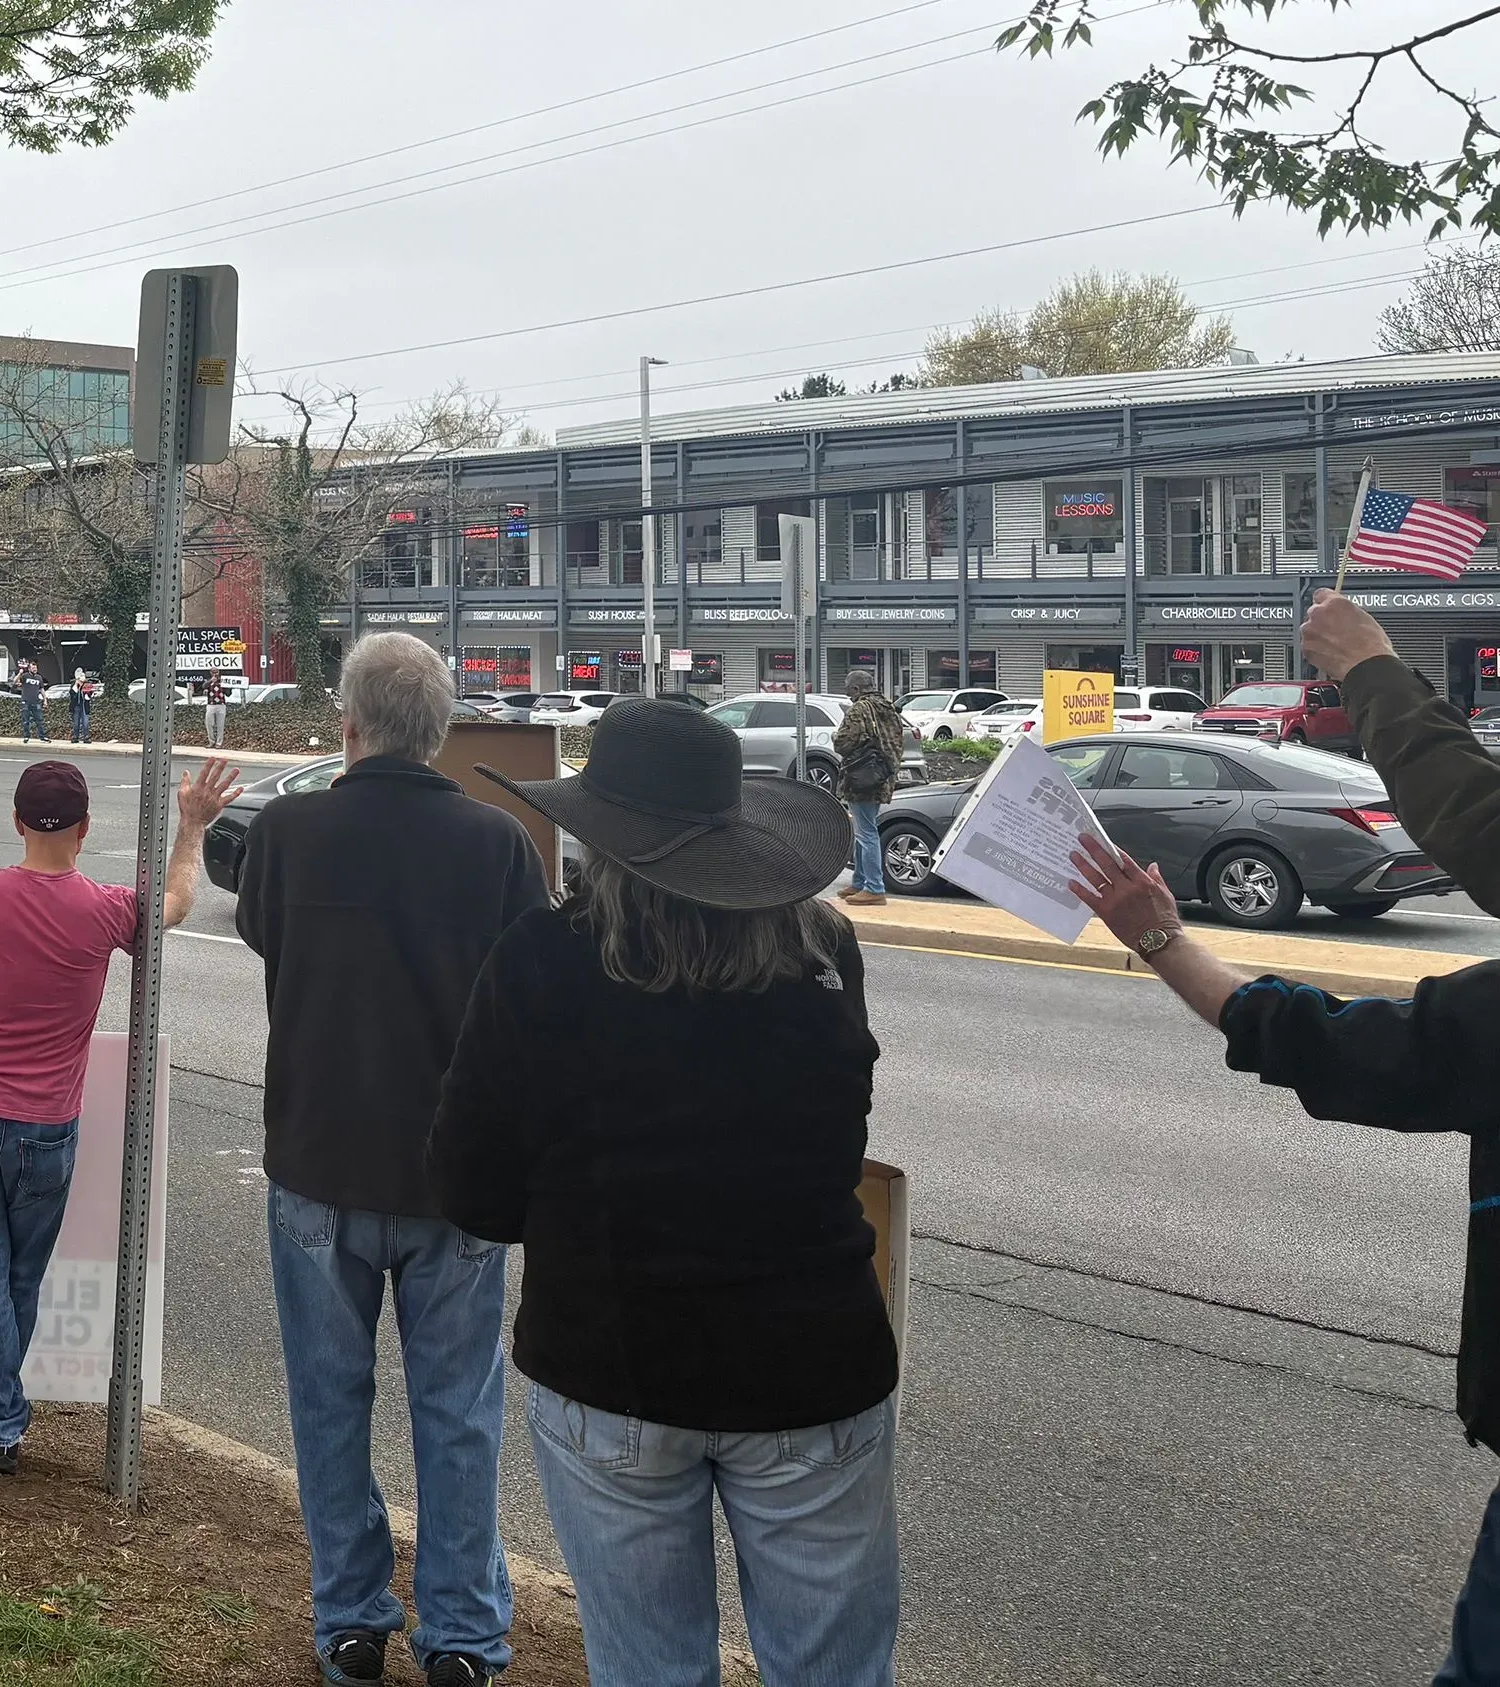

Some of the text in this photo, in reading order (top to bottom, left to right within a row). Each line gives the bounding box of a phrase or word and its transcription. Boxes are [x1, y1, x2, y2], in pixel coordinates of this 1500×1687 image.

[1351, 417, 1374, 429] THE
[1439, 411, 1457, 423] OF
[1063, 492, 1105, 503] MUSIC
[1055, 504, 1114, 517] LESSONS
[1348, 593, 1494, 607] ATURE CIGARS & CIGS
[497, 611, 521, 620] HALAL
[522, 611, 543, 620] MEAT
[588, 611, 609, 620] SUSHI
[611, 611, 636, 620] HOUSE
[704, 610, 727, 619] BLISS
[836, 609, 852, 619] BUY
[858, 609, 875, 619] SELL
[880, 609, 914, 619] JEWELRY
[919, 609, 945, 619] COINS
[1010, 608, 1081, 619] CRISP & JUICY
[1161, 607, 1293, 619] CHARBROILED CHICKEN
[177, 630, 235, 641] TAIL SPACE
[188, 643, 222, 653] LEASE
[572, 665, 599, 678] MEAT
[1062, 693, 1110, 709] SUNSHINE
[1068, 710, 1105, 726] SQUARE
